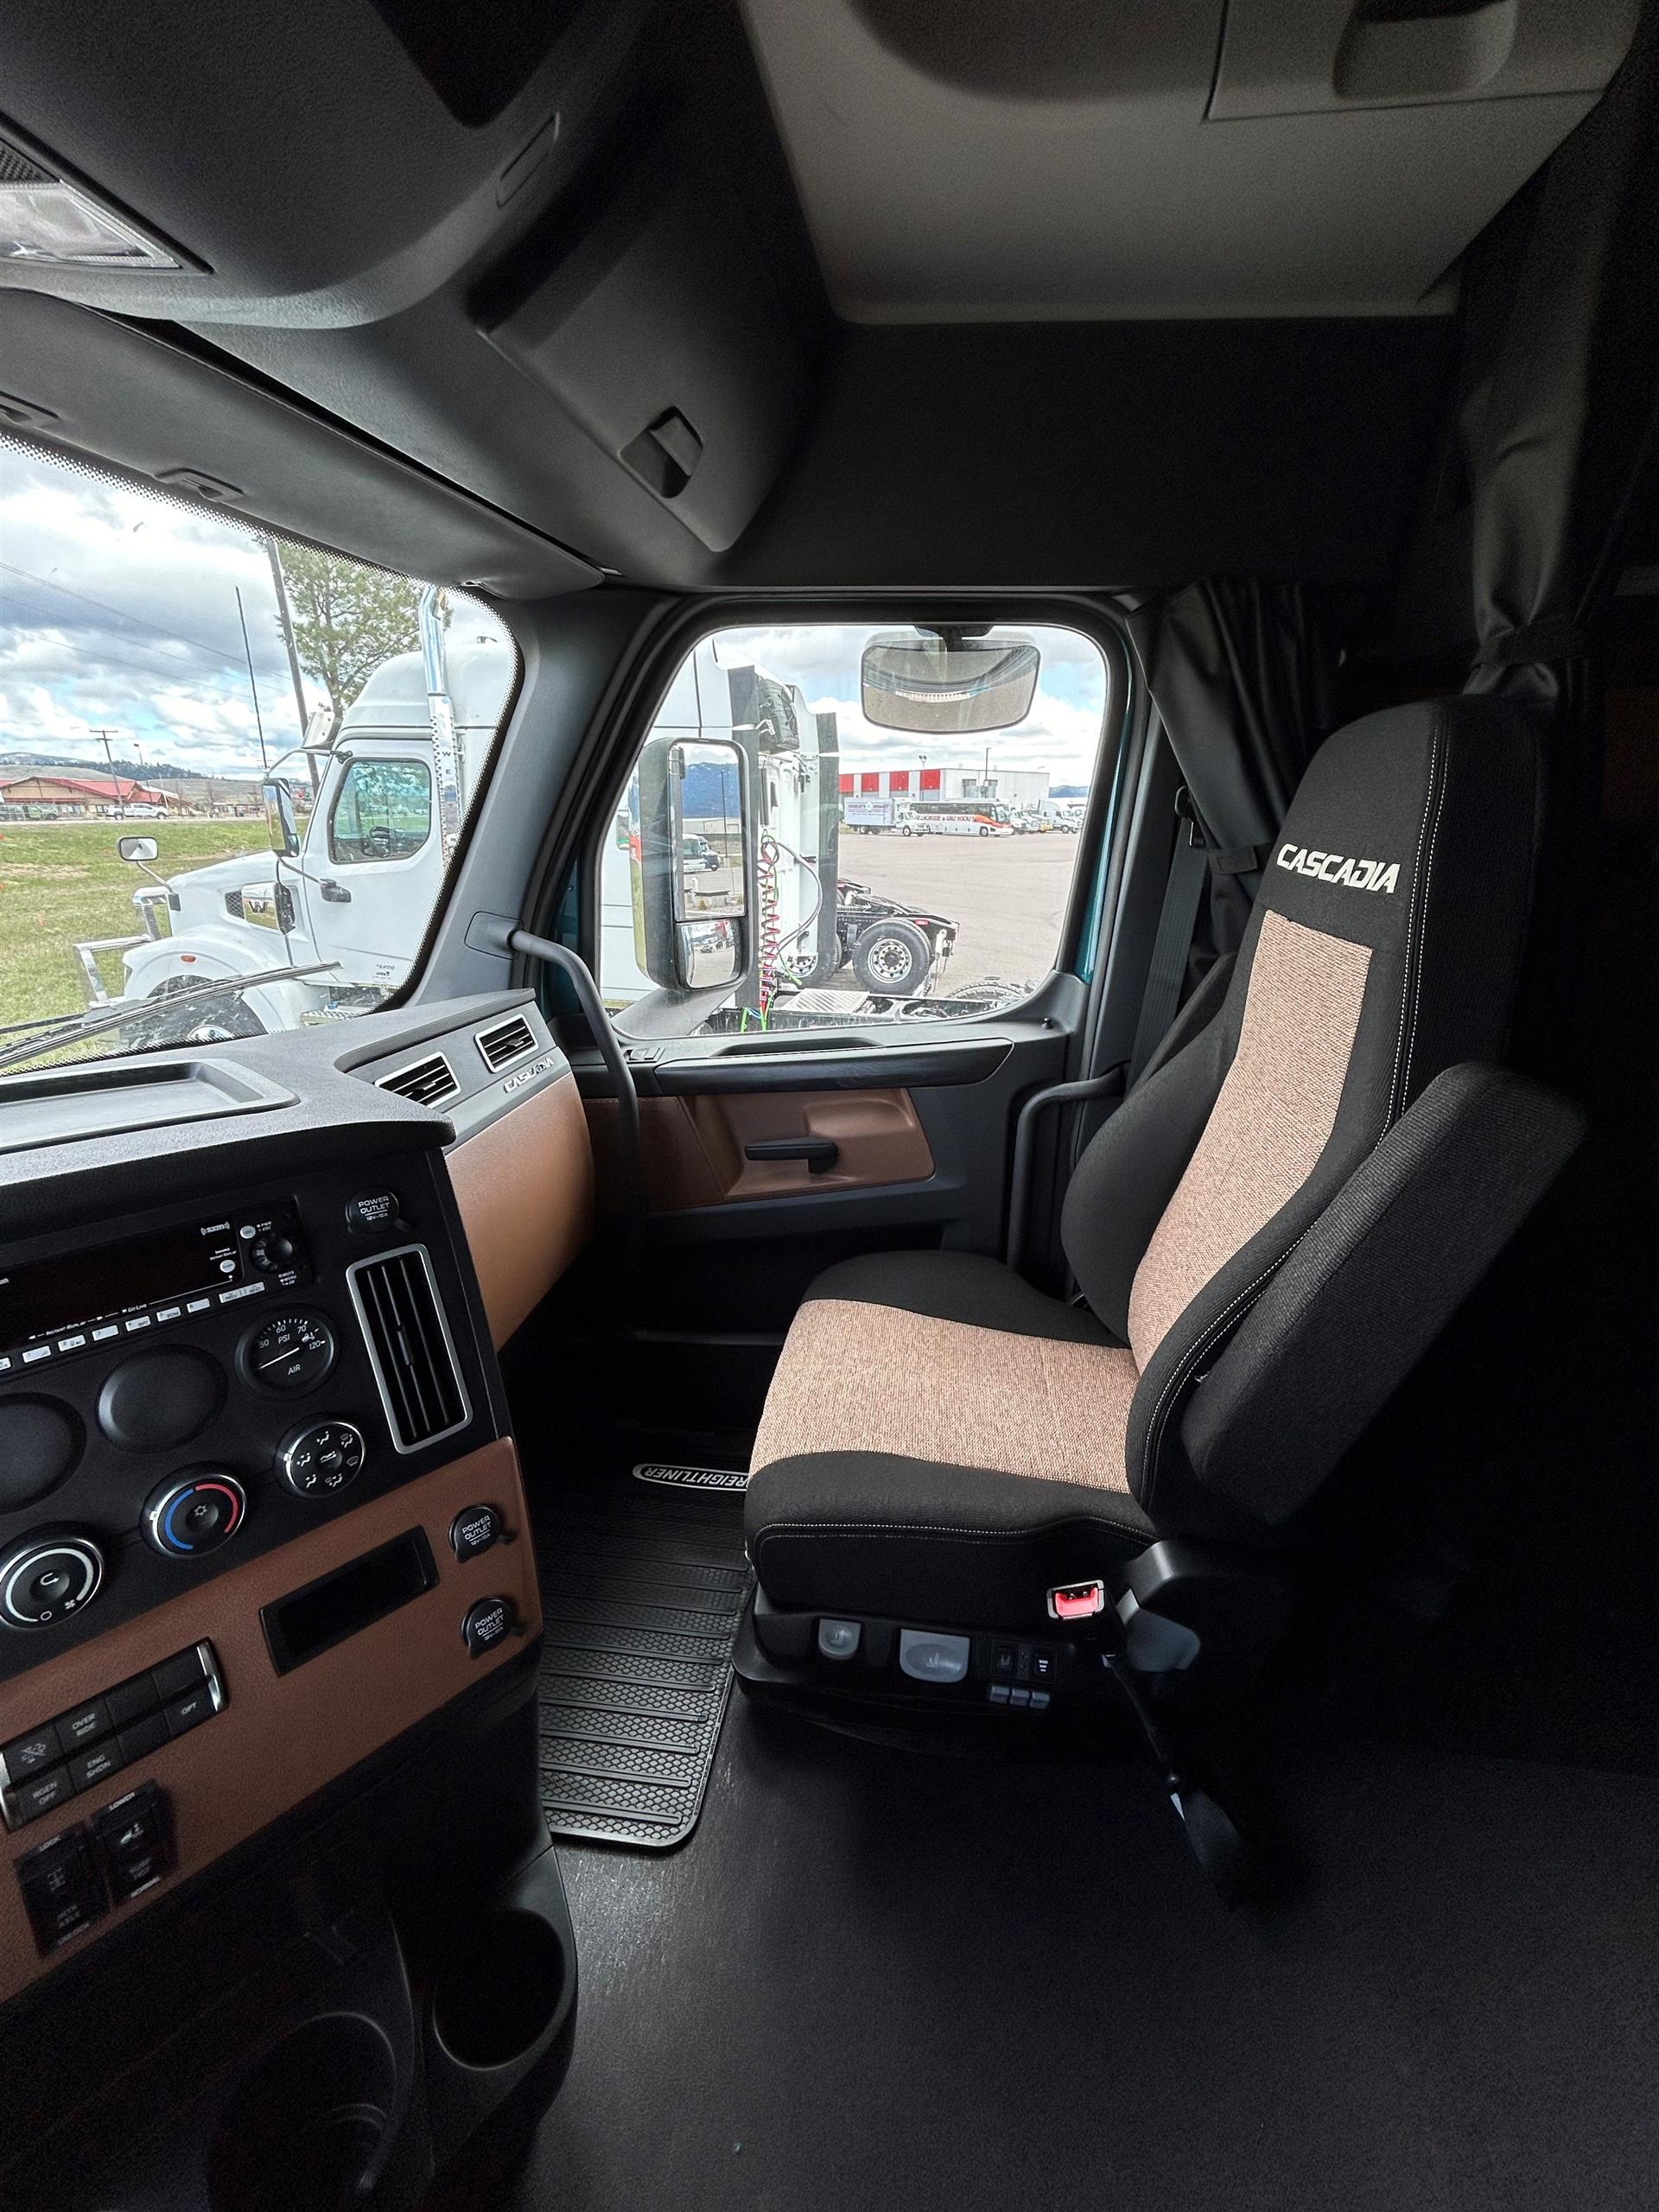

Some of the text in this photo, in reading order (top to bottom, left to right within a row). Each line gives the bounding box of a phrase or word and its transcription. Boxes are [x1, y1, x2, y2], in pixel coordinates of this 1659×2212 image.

[1276, 842, 1401, 893] CASCADIA
[504, 1057, 555, 1093] CASCADIA
[358, 1195, 389, 1208] POWER
[359, 1202, 390, 1214] OUTLET
[276, 1325, 287, 1334] 60
[297, 1325, 307, 1334] 70
[259, 1338, 270, 1349] 50
[277, 1333, 290, 1344] PSI
[308, 1339, 321, 1351] 120
[287, 1363, 301, 1376] AIR
[644, 1467, 748, 1487] REIGHTLINER
[461, 1515, 491, 1535] POWER
[464, 1522, 492, 1541] OUTLET
[474, 1607, 503, 1630] POWER
[477, 1613, 504, 1636] OUTLET
[72, 1713, 95, 1730] OVER
[108, 1791, 136, 1811] LOWER
